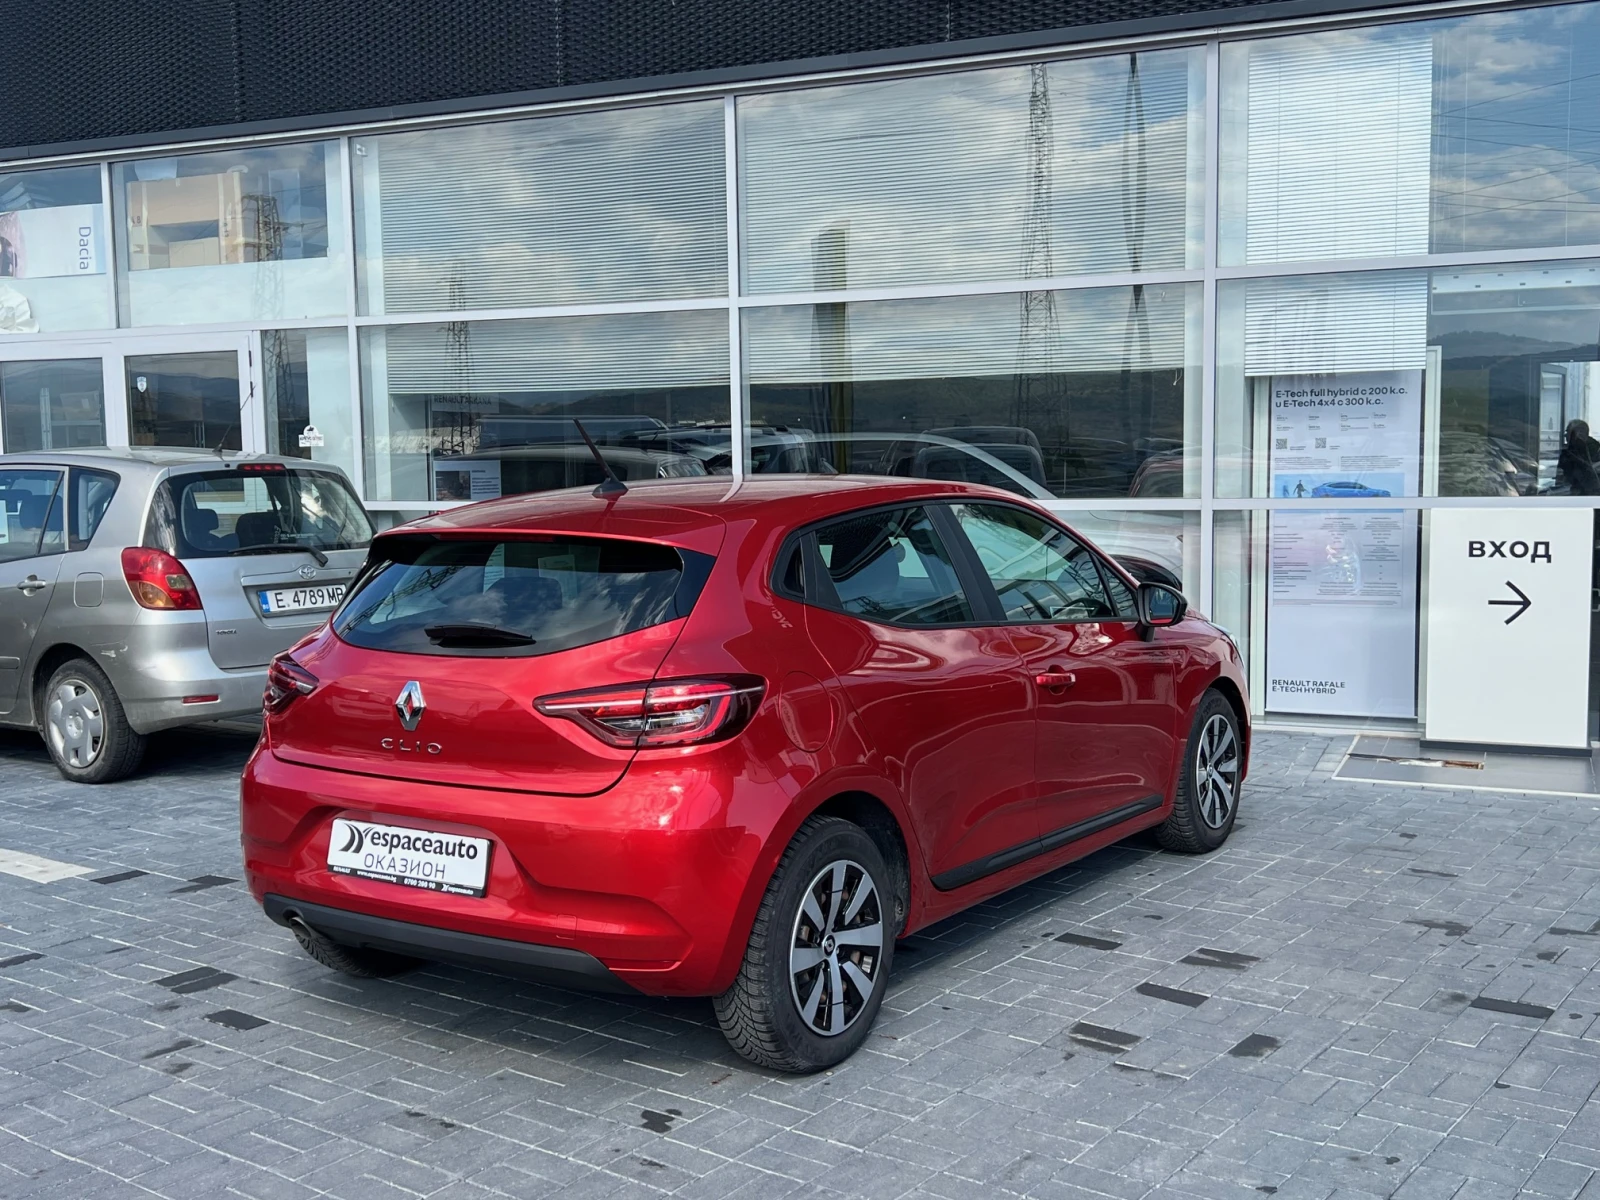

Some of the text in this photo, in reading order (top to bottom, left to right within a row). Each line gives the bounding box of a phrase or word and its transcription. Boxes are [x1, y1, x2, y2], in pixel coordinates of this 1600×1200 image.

[79, 226, 92, 270] Dacia
[1275, 389, 1309, 398] E-Tech
[1310, 388, 1326, 397] full
[1327, 387, 1359, 398] hybrid
[1368, 386, 1389, 395] 200
[1283, 399, 1316, 408] E-Tech
[1317, 398, 1336, 407] 4x4
[1345, 397, 1365, 406] 300
[1467, 540, 1552, 564] ВХОД
[292, 588, 325, 607] 4789
[1271, 679, 1346, 689] RENAULT RAFALE
[1271, 685, 1337, 695] E-TECH HYBRID
[380, 737, 443, 755] CLIO
[370, 830, 478, 860] espaceauto
[363, 853, 446, 880] ОКАЗИОН
